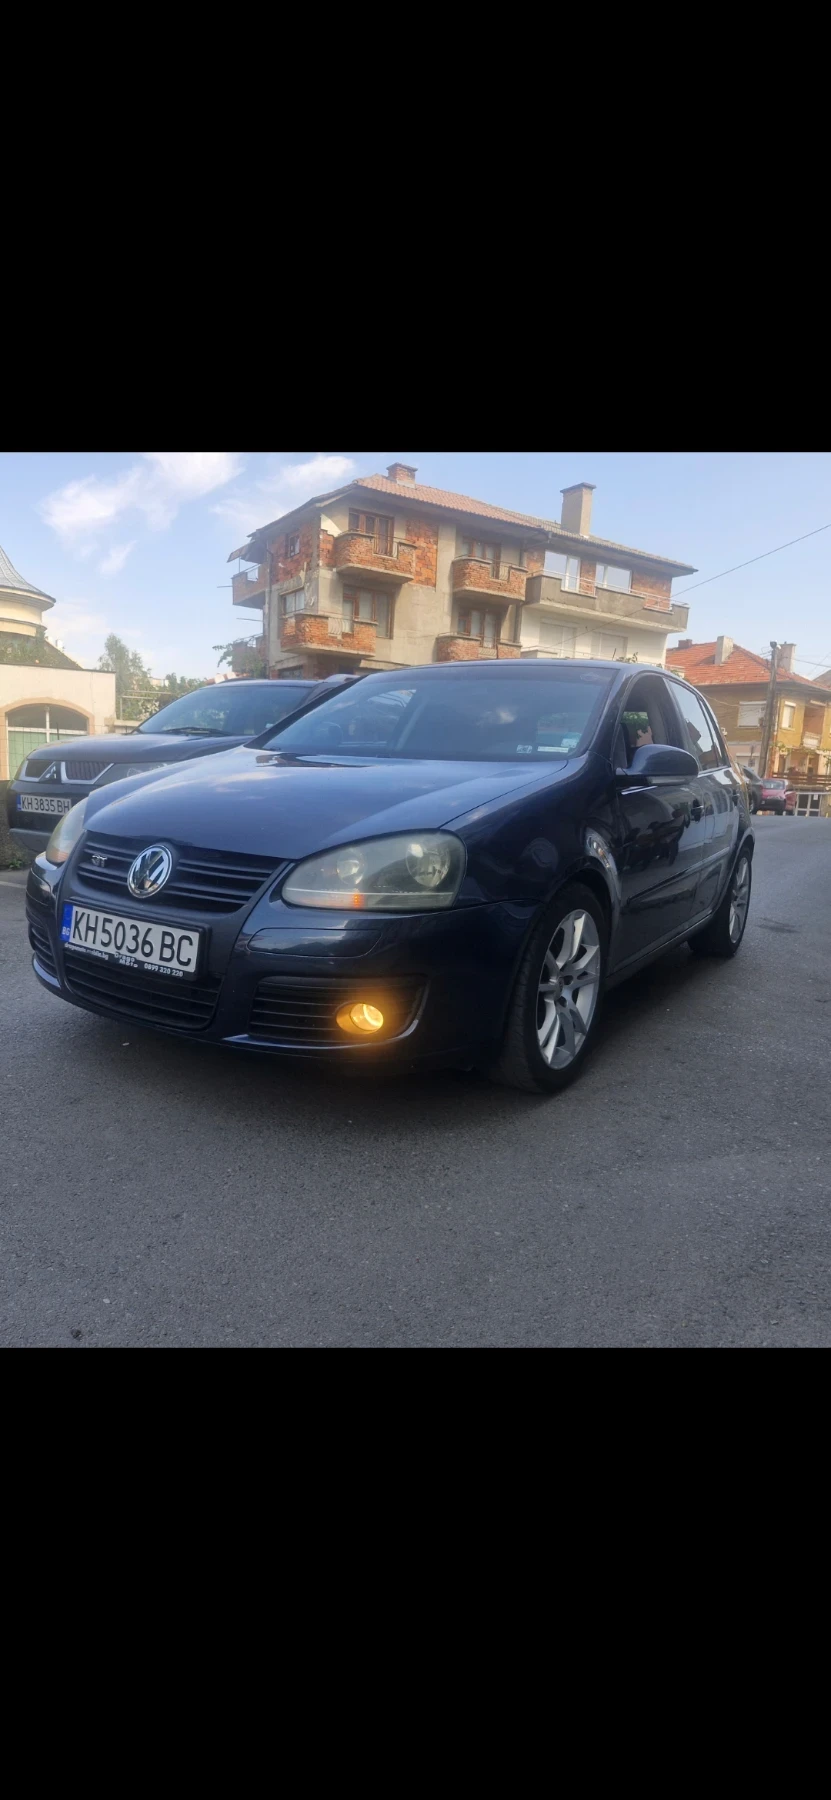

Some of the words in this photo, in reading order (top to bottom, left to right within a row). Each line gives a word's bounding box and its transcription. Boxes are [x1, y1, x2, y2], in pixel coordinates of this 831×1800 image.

[21, 796, 33, 810] KH
[34, 798, 56, 812] 3835
[57, 800, 70, 814] BH
[61, 926, 71, 936] BG
[72, 910, 99, 945] KH
[100, 917, 154, 958] 5036
[159, 931, 193, 967] BC
[144, 963, 159, 972] 0899
[159, 966, 171, 975] 320
